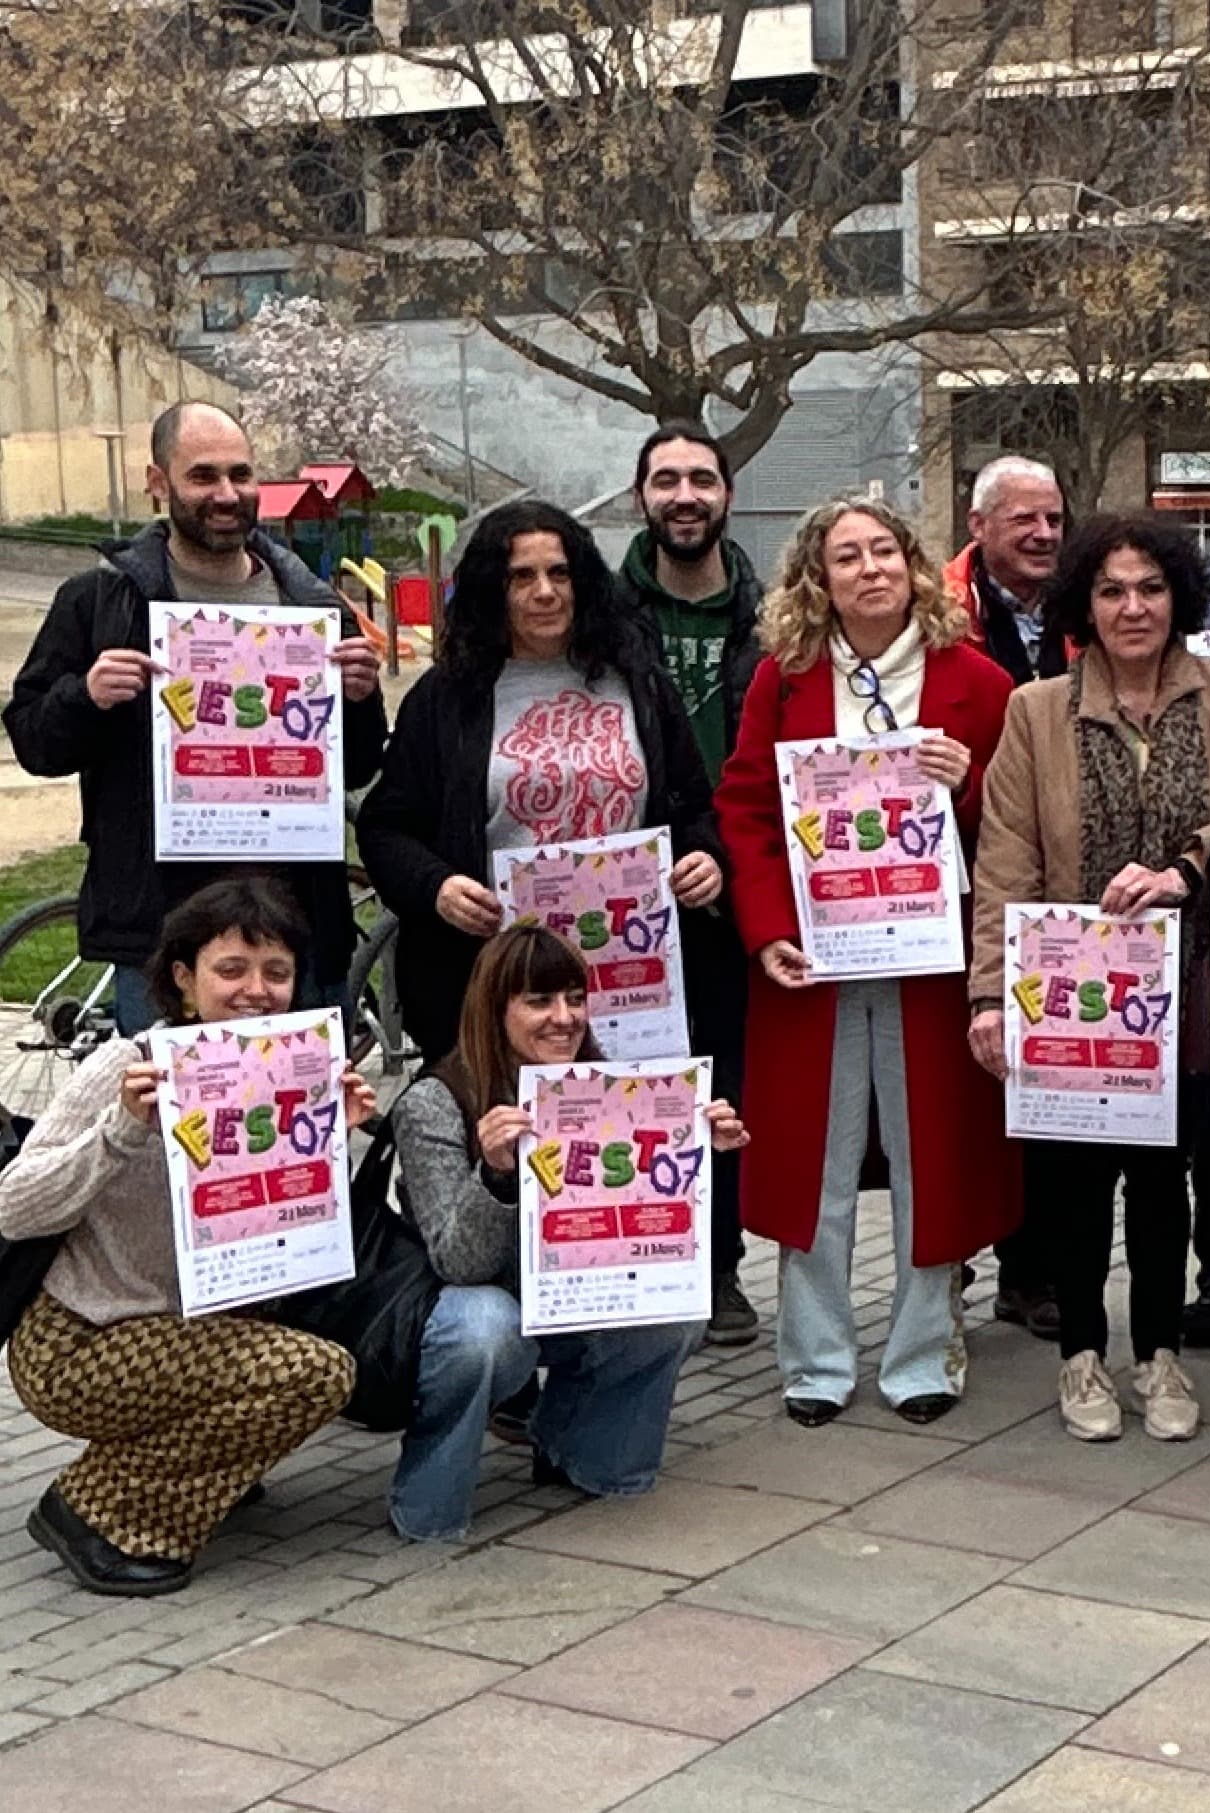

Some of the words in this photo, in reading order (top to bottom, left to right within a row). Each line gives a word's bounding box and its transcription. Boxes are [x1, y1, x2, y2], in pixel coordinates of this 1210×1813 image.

[160, 673, 300, 734] FEST
[282, 694, 336, 741] 07
[264, 784, 282, 796] 21
[791, 797, 913, 860] FEST
[899, 811, 946, 858] 07
[511, 897, 638, 950] ST
[623, 906, 671, 953] 07
[887, 902, 904, 914] 21
[609, 995, 627, 1007] 21
[1011, 970, 1140, 1025] FEST
[1121, 991, 1172, 1036] 07
[1102, 1073, 1119, 1086] 21
[172, 1088, 307, 1172] FEST
[289, 1099, 338, 1157] 07
[526, 1128, 669, 1199] FEST
[649, 1145, 705, 1197] 07
[278, 1208, 295, 1221] 21
[629, 1243, 650, 1257] 21
